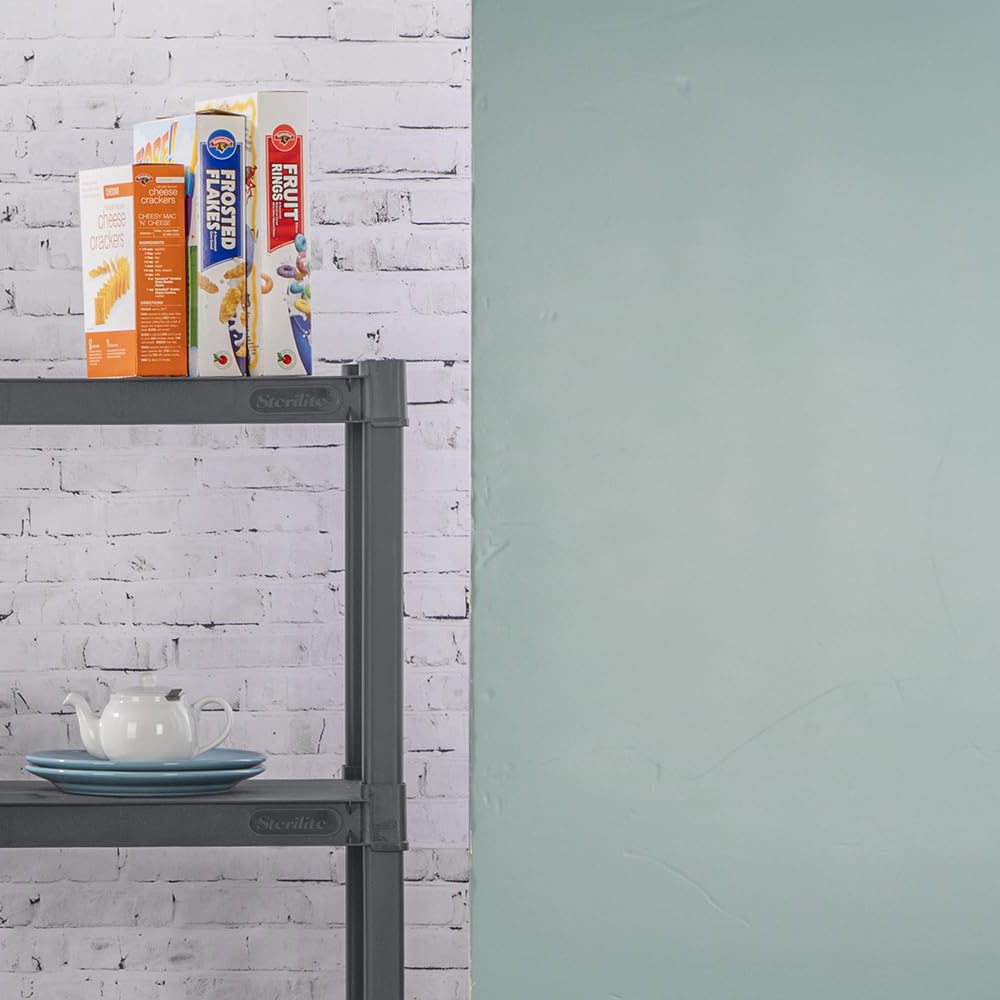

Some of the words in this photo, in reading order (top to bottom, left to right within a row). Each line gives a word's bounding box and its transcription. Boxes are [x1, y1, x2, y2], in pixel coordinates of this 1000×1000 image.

[149, 187, 178, 197] cheese
[272, 164, 283, 202] RINGS
[283, 164, 298, 221] FRUIT
[141, 196, 176, 204] crackers
[206, 169, 220, 231] FLAKES
[221, 169, 236, 250] FROSTED
[97, 210, 126, 230] cheese
[89, 230, 125, 251] crackers
[256, 393, 328, 409] Sterilite
[256, 815, 327, 830] Sterilite
